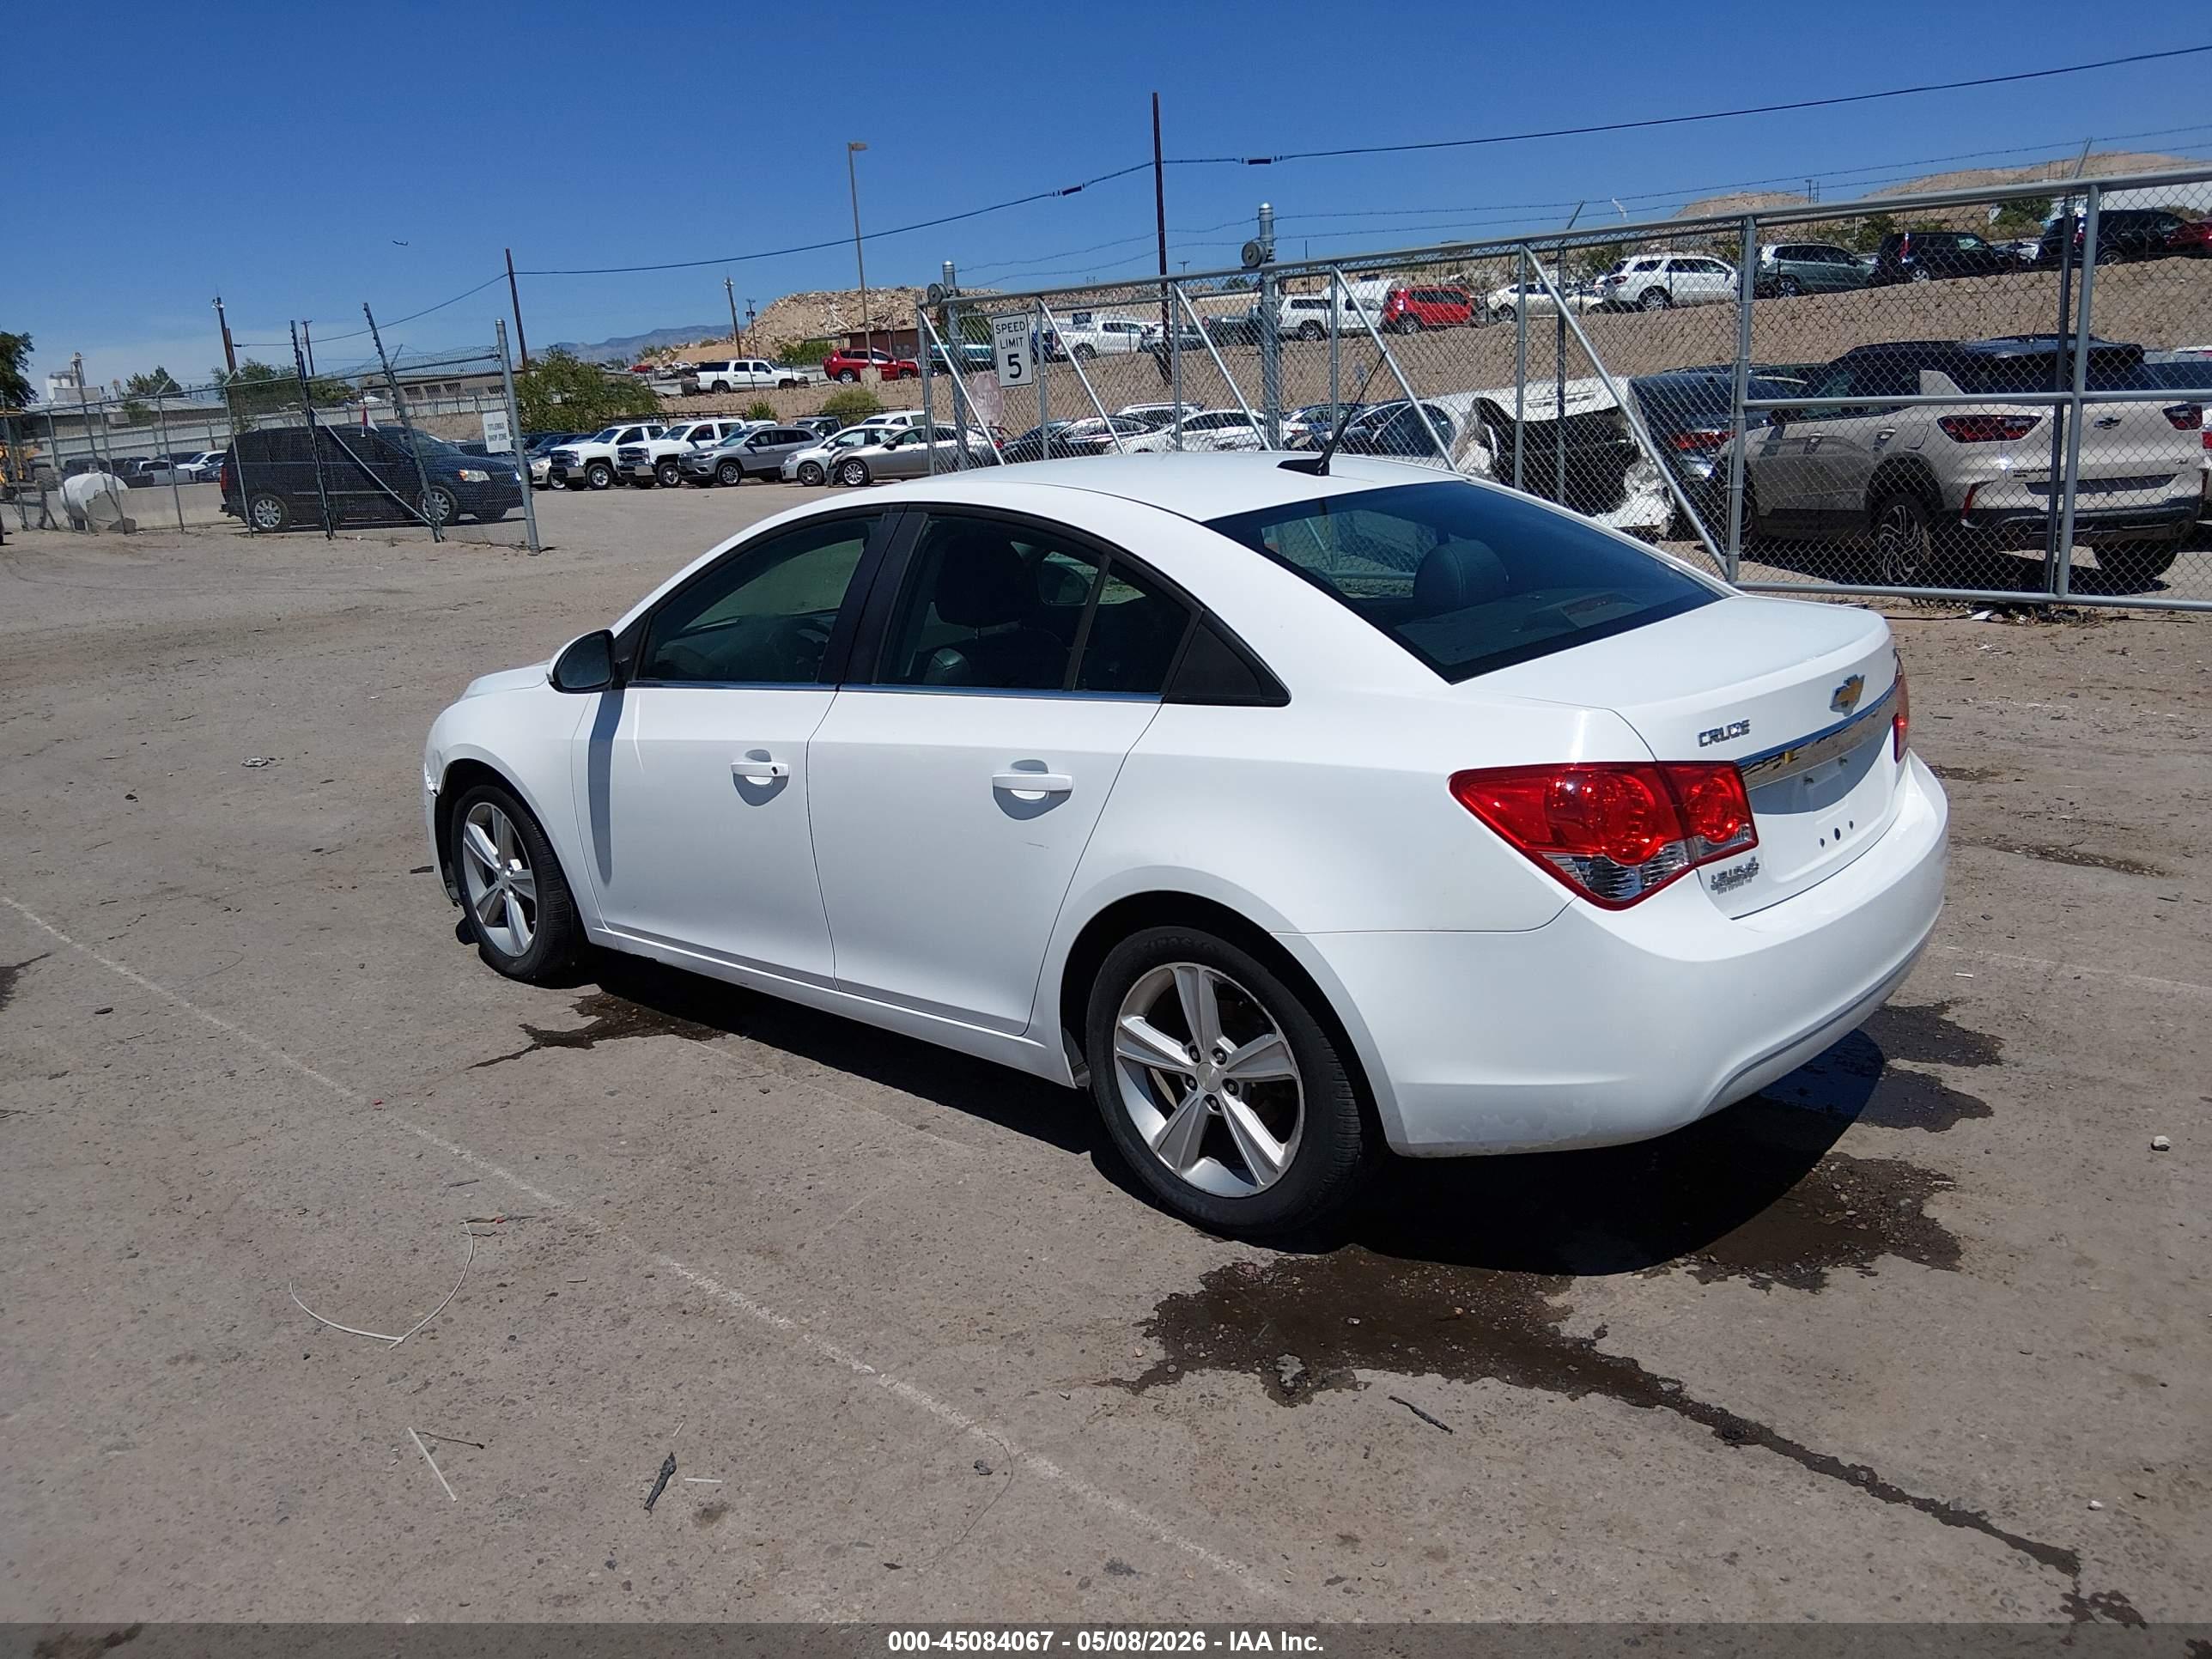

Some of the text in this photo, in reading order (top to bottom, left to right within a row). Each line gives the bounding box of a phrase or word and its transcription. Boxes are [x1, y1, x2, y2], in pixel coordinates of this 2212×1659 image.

[995, 321, 1025, 334] SPEED
[1000, 337, 1024, 349] LIMIT
[1007, 353, 1022, 380] 5
[976, 391, 999, 407] STOP
